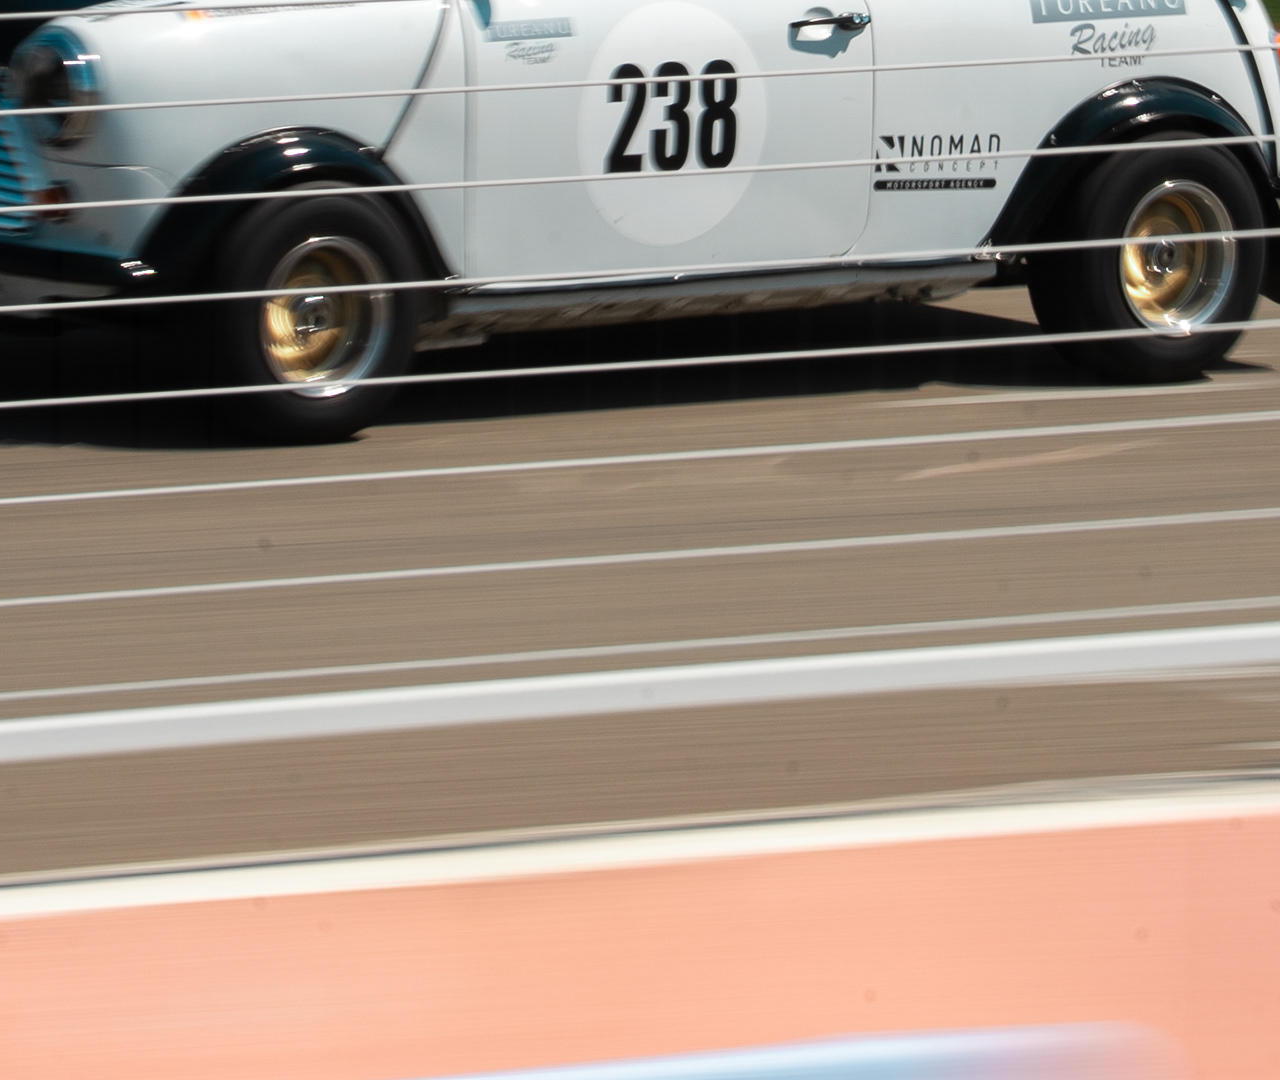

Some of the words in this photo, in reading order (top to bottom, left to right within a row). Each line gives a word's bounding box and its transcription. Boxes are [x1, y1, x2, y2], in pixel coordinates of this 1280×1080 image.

[1070, 22, 1157, 56] Racing
[1100, 54, 1142, 68] TEAM
[604, 58, 738, 174] 238
[911, 133, 1001, 158] NOMAD
[909, 159, 999, 173] CONCEPT
[886, 180, 946, 190] MOTORSPORT
[949, 179, 984, 189] AGENCY
